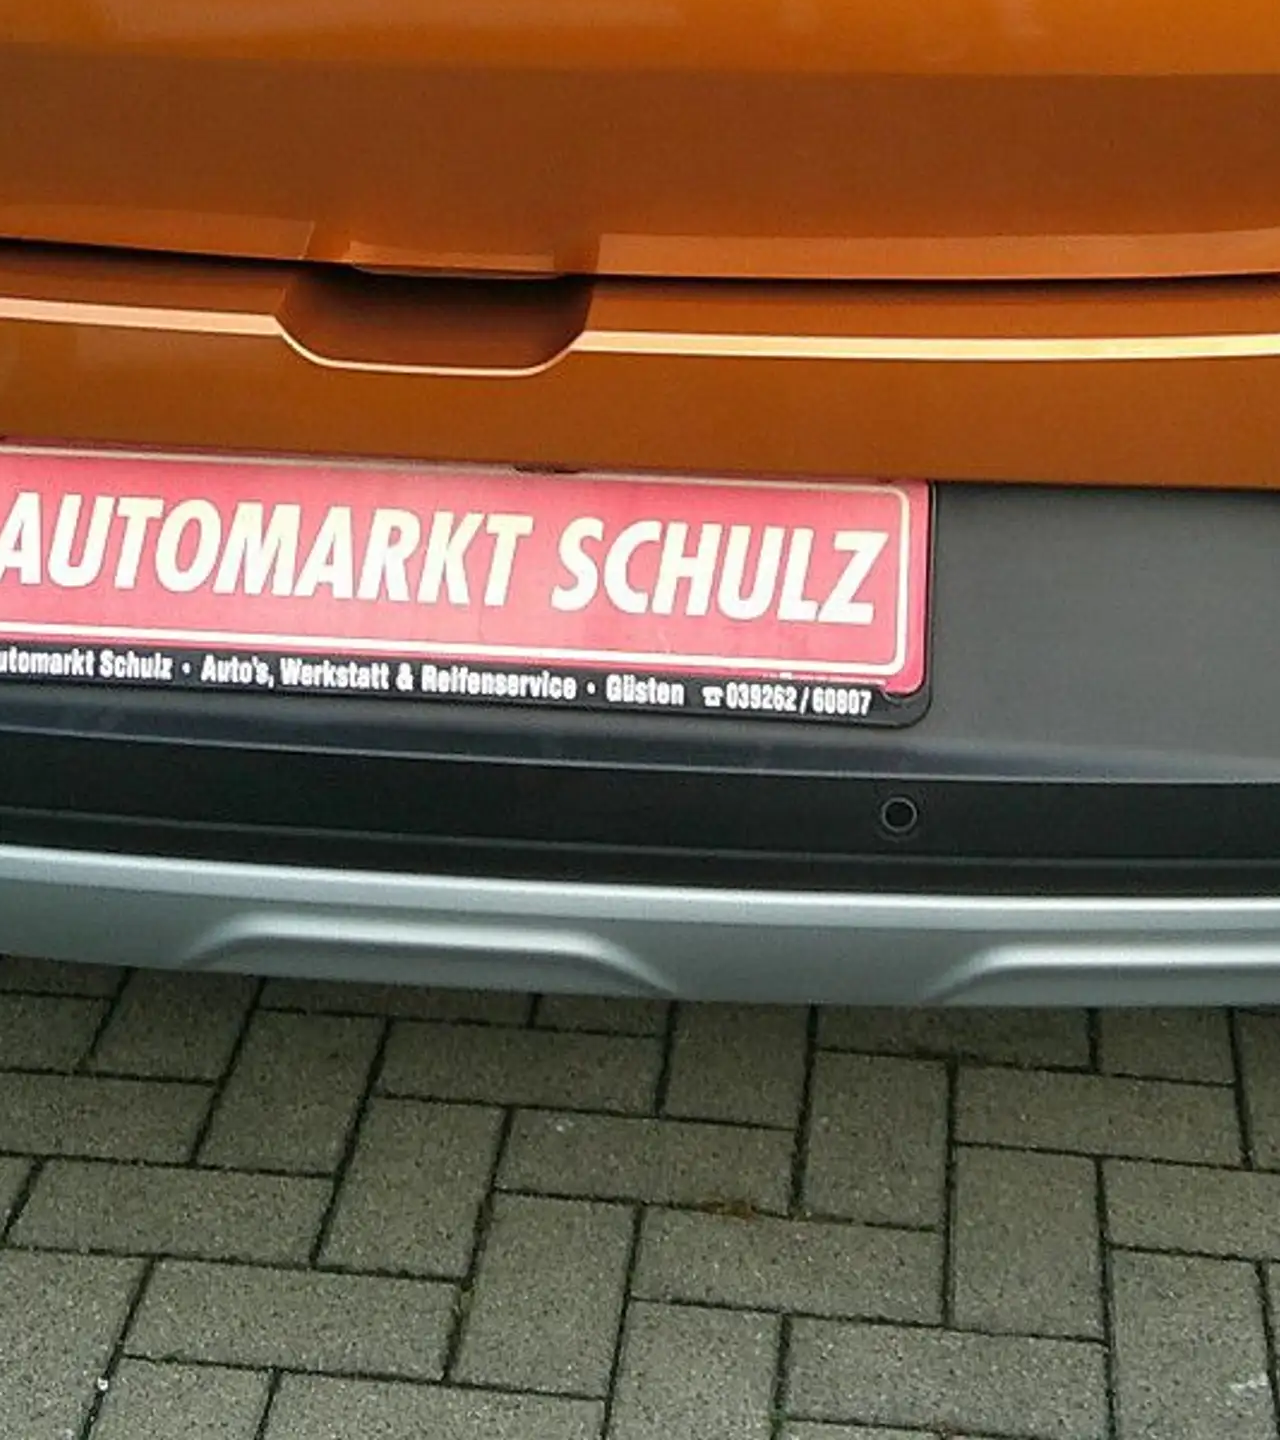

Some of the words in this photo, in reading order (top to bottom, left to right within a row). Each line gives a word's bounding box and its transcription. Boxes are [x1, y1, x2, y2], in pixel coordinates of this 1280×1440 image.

[550, 517, 889, 626] SCHULZ
[99, 649, 173, 680] Schulz
[279, 657, 390, 690] Werkstatt
[395, 661, 415, 692] &
[420, 663, 578, 700] Reifenservice
[605, 673, 686, 706] Güsten
